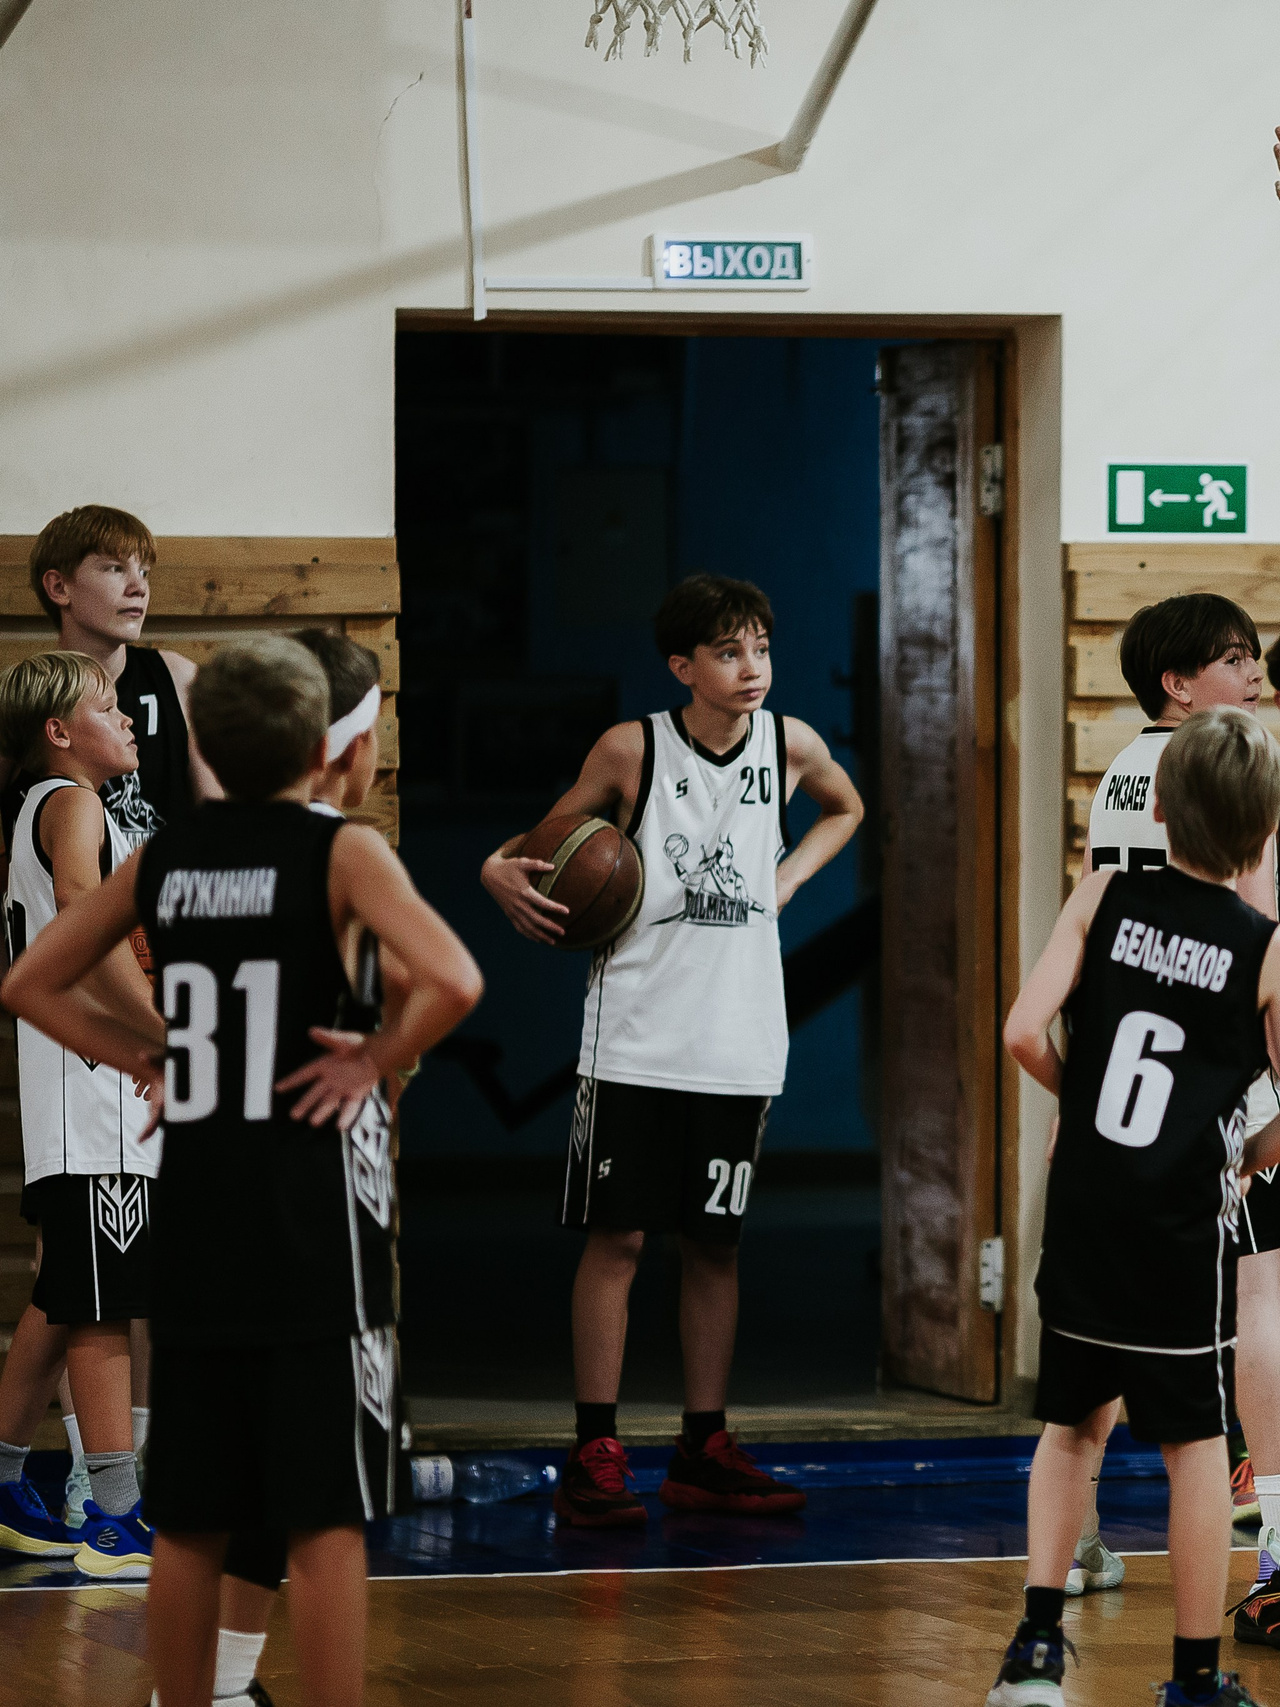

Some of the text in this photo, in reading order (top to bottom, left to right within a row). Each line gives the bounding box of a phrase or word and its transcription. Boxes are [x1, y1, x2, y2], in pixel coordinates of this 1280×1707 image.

[669, 245, 797, 279] ВЫХОД
[139, 693, 158, 736] 7
[739, 765, 772, 805] 20
[1104, 774, 1151, 811] РИЗАЕВ
[156, 867, 277, 927] ДРУЖИНИН
[1110, 918, 1233, 993] БЕЛЬДЕКОВ
[163, 959, 280, 1123] 31
[1094, 1010, 1186, 1148] 6
[704, 1158, 752, 1216] 20
